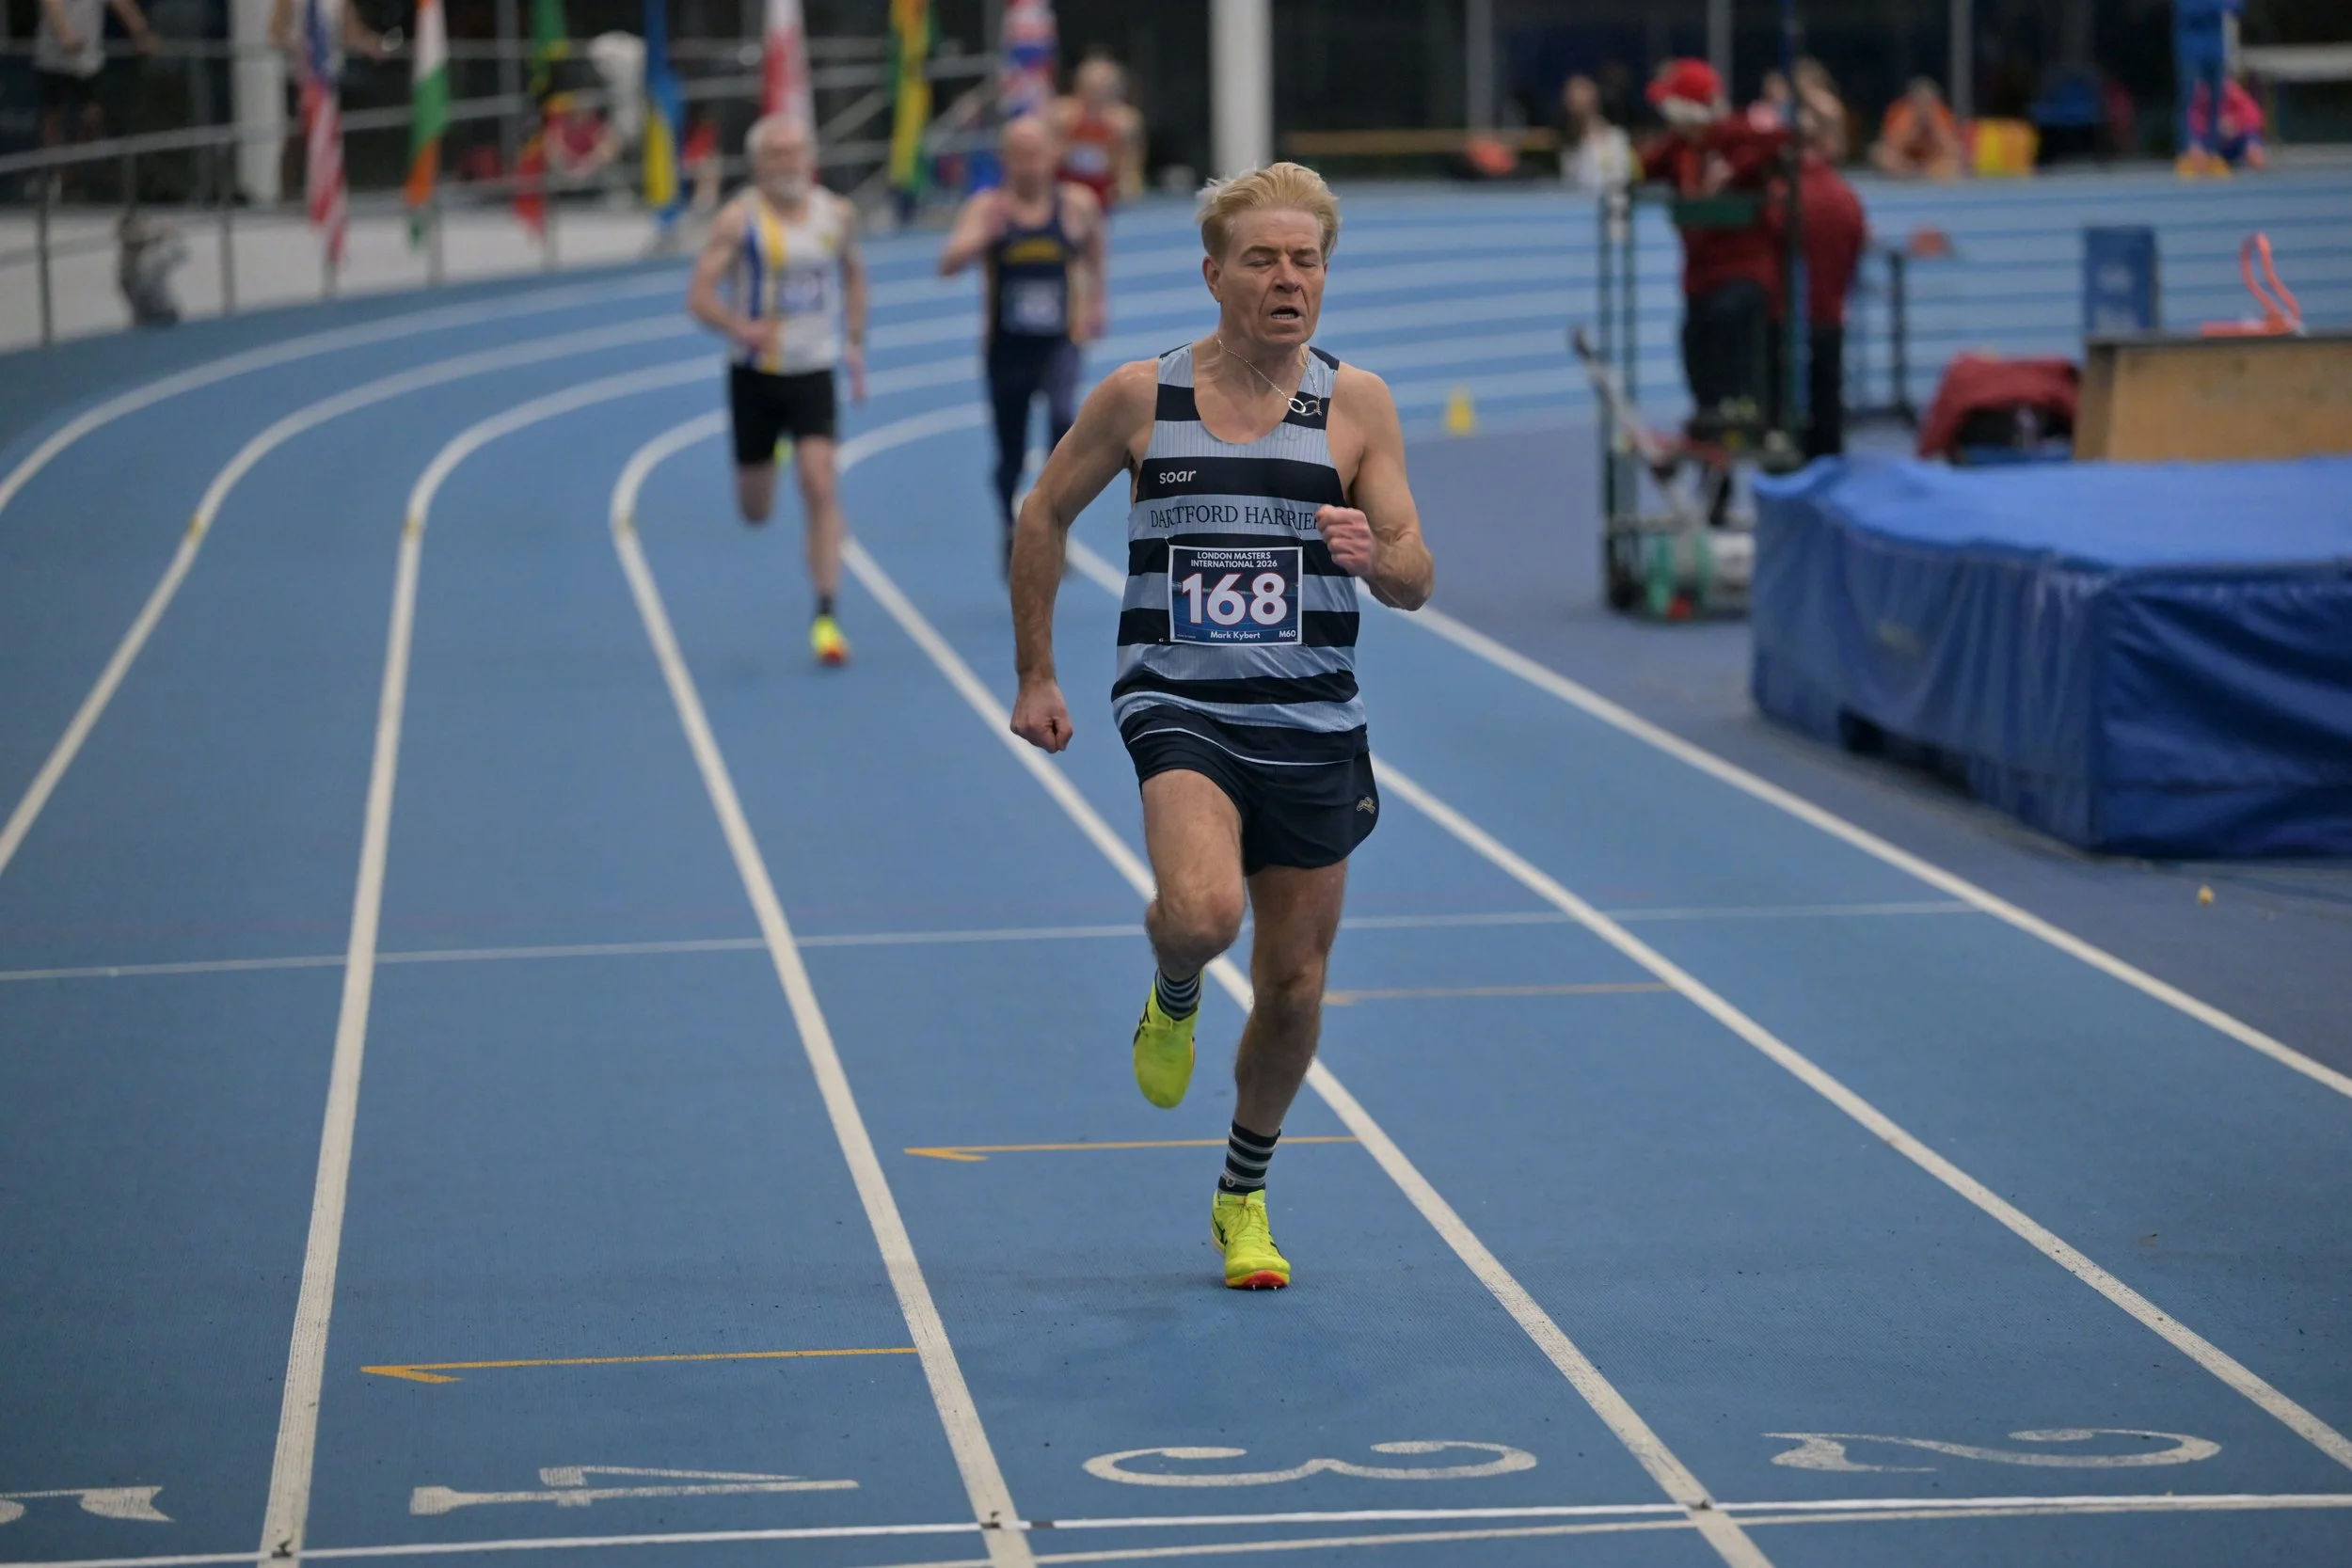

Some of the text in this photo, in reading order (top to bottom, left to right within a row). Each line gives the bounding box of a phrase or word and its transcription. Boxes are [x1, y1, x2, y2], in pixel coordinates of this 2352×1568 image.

[1159, 469, 1197, 484] soar
[1151, 505, 1238, 530] DARTFORD
[1191, 560, 1278, 568] INTERNATIONAL 2026
[1198, 551, 1271, 561] LONDON MASTERS
[1182, 572, 1288, 626] 168
[1233, 631, 1261, 641] Kybert
[1279, 629, 1296, 638] M60
[1760, 1428, 2222, 1472] 2
[1082, 1441, 1537, 1486] 3
[409, 1465, 860, 1515] 4
